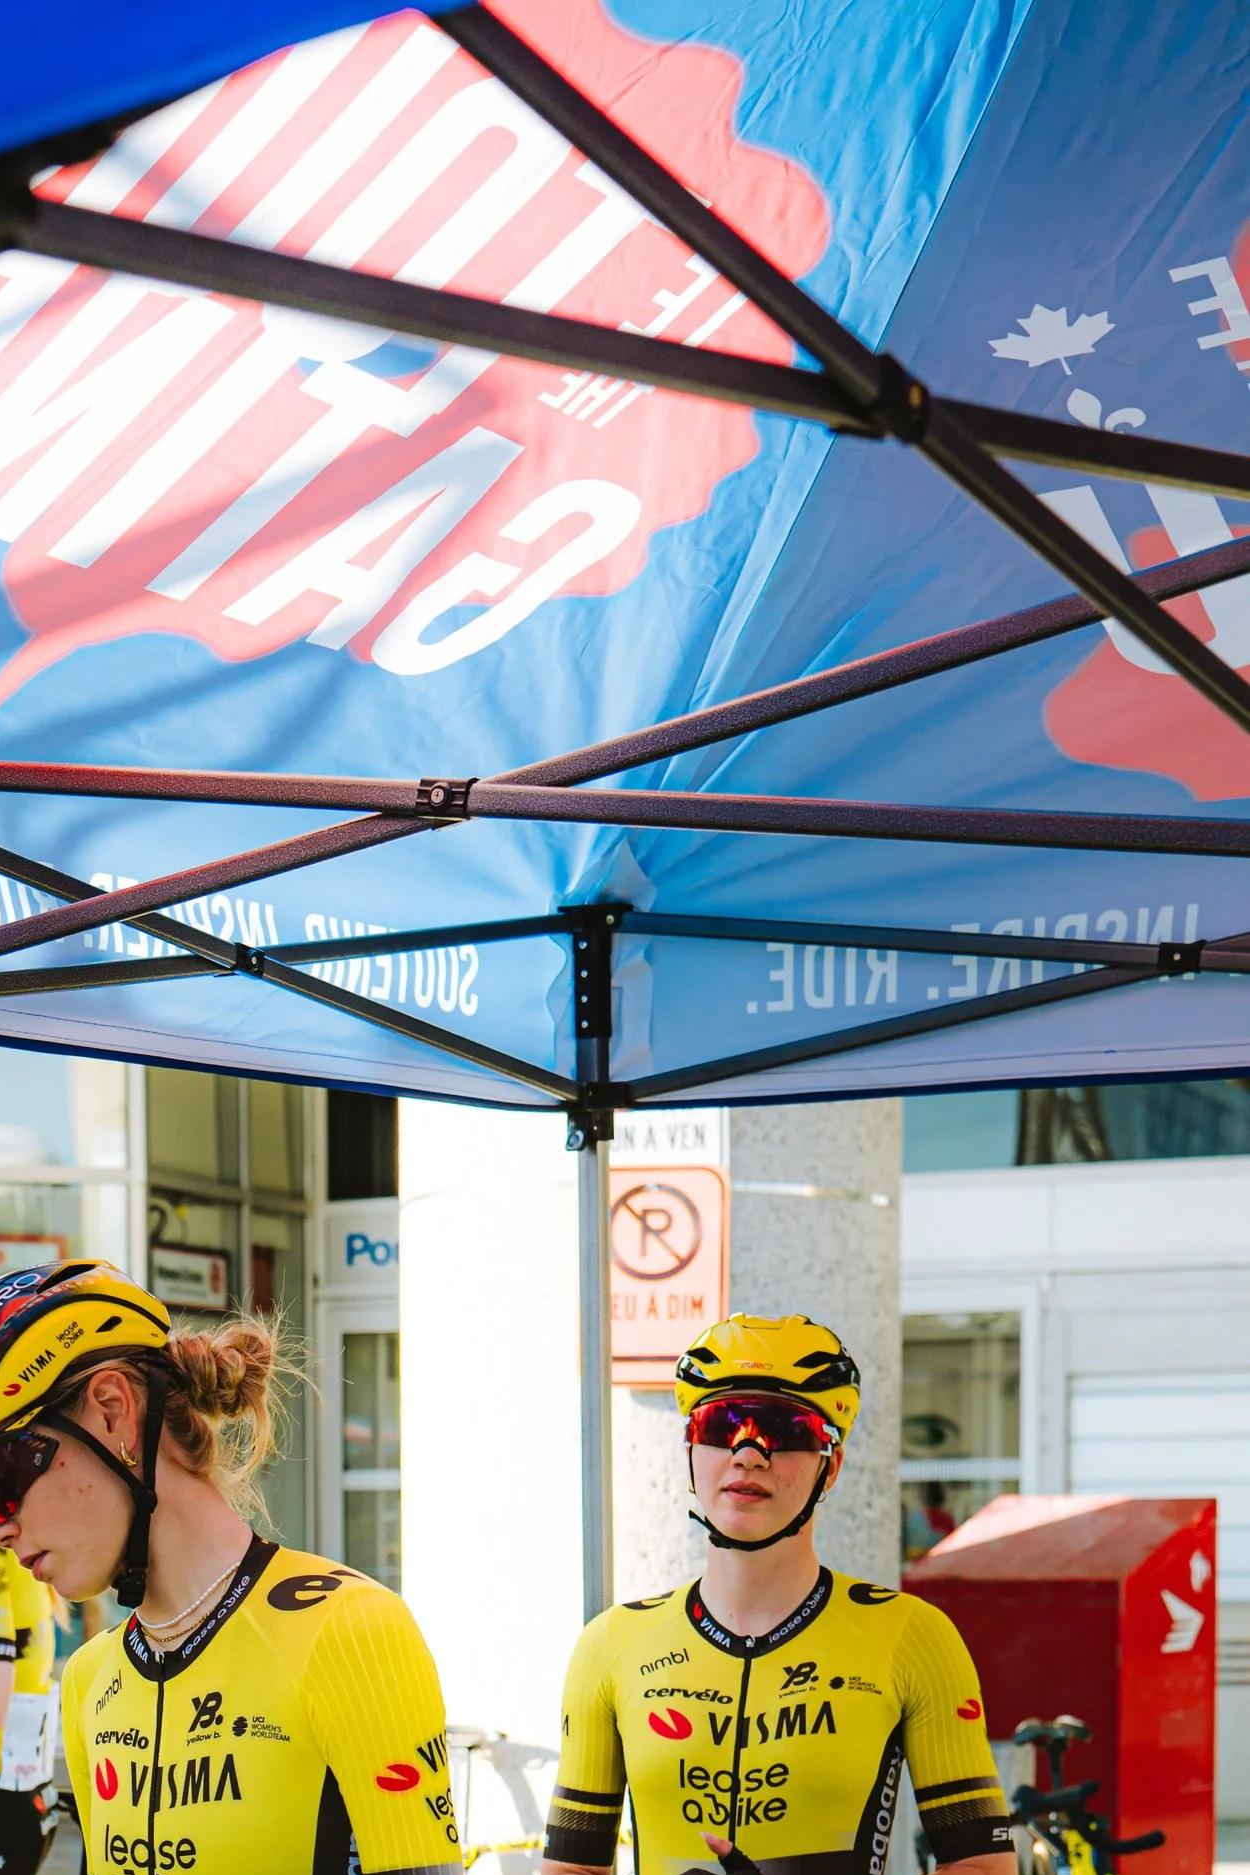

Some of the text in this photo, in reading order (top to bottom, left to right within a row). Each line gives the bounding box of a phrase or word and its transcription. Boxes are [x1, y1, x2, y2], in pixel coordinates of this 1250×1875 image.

[667, 1123, 707, 1150] VEN
[611, 1296, 637, 1320] EU
[668, 1294, 705, 1320] DIM
[18, 1348, 56, 1383] VISMA
[181, 1618, 217, 1660] lease
[699, 1616, 731, 1649] VISMA
[768, 1613, 803, 1644] lease
[127, 1629, 150, 1665] VISMA
[640, 1647, 691, 1676] nimbl
[94, 1668, 123, 1715] nimbl
[643, 1686, 733, 1705] cervélo
[251, 1715, 266, 1724] UCI
[251, 1722, 283, 1734] WOMEN'S
[708, 1700, 838, 1749] VISMA
[95, 1726, 150, 1751] cervélo
[186, 1734, 212, 1747] yellow
[250, 1730, 291, 1743] WORLDTEAM
[130, 1753, 242, 1813] VISMA
[679, 1757, 790, 1794] lease
[104, 1824, 197, 1871] lease
